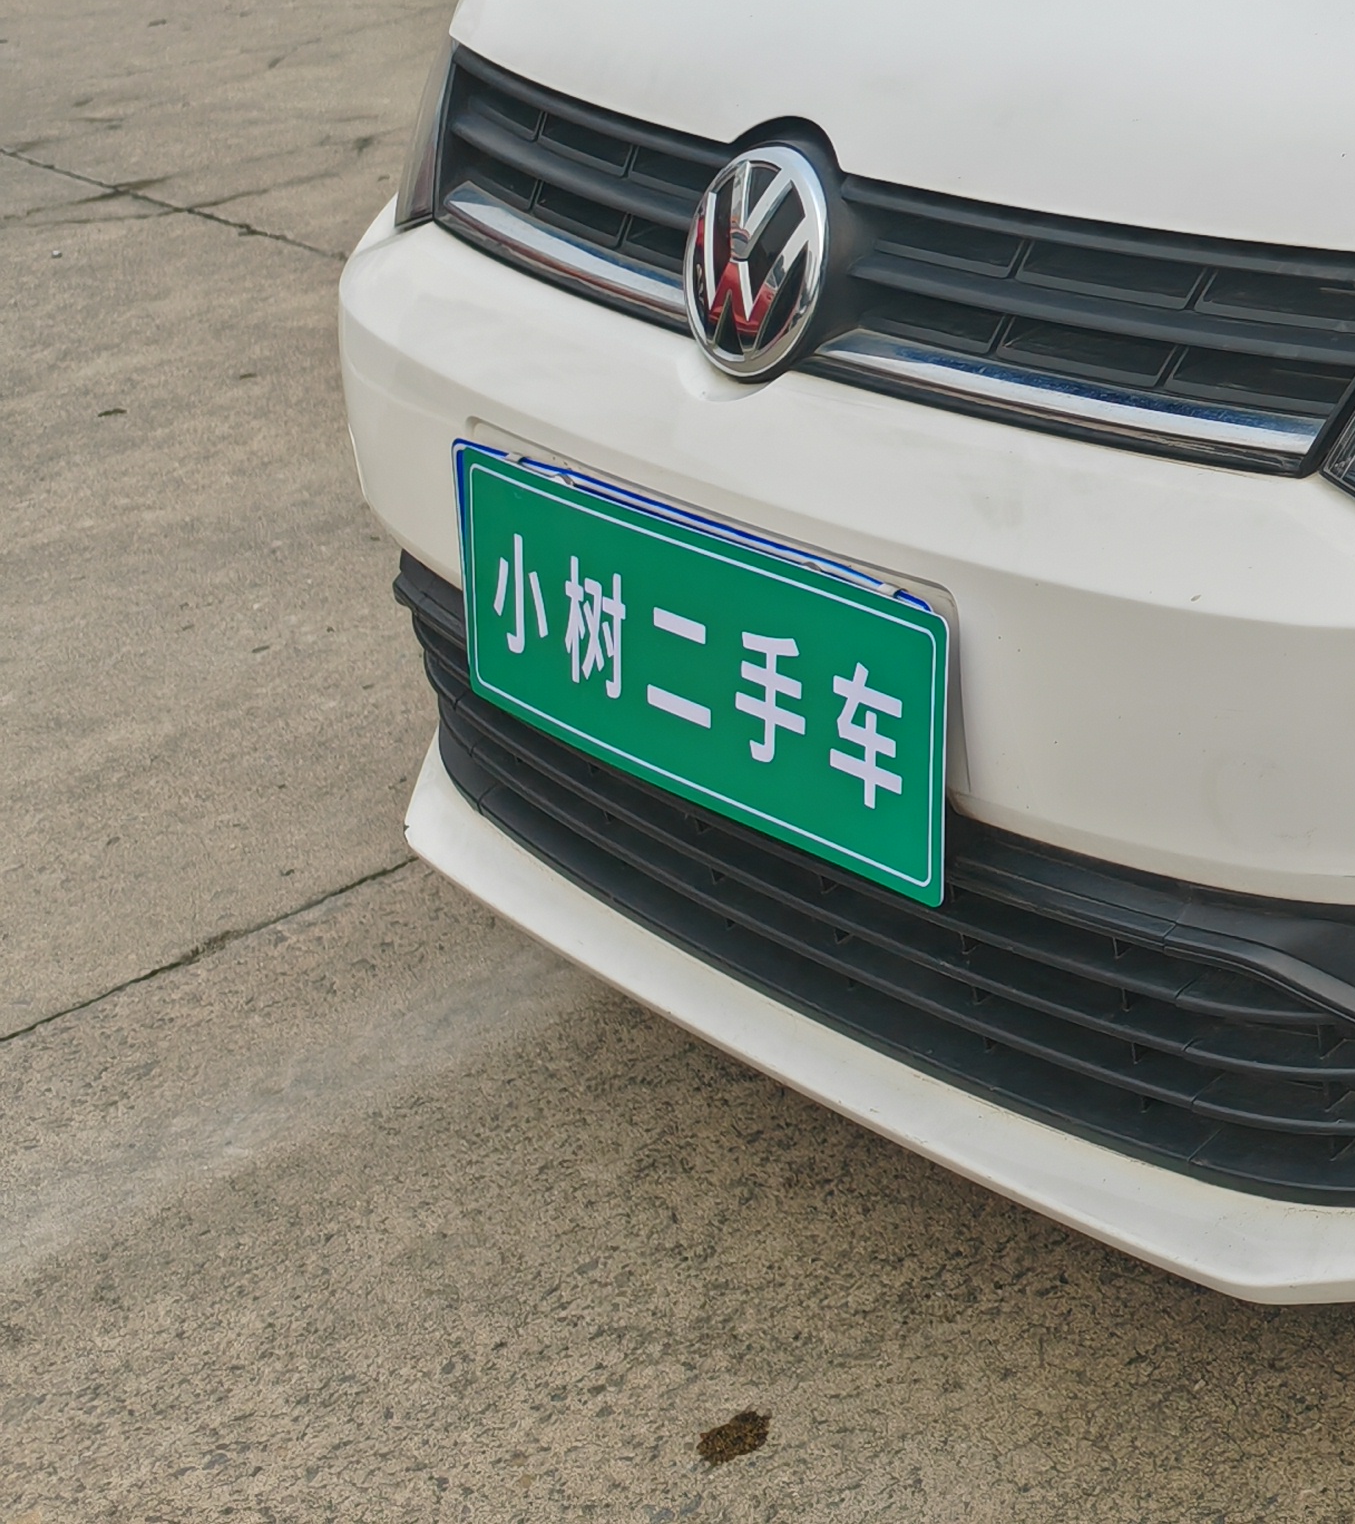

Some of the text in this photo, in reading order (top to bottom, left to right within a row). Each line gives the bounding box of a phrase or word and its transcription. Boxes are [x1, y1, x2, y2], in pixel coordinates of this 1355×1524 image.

[493, 533, 903, 809] 小树二手车
